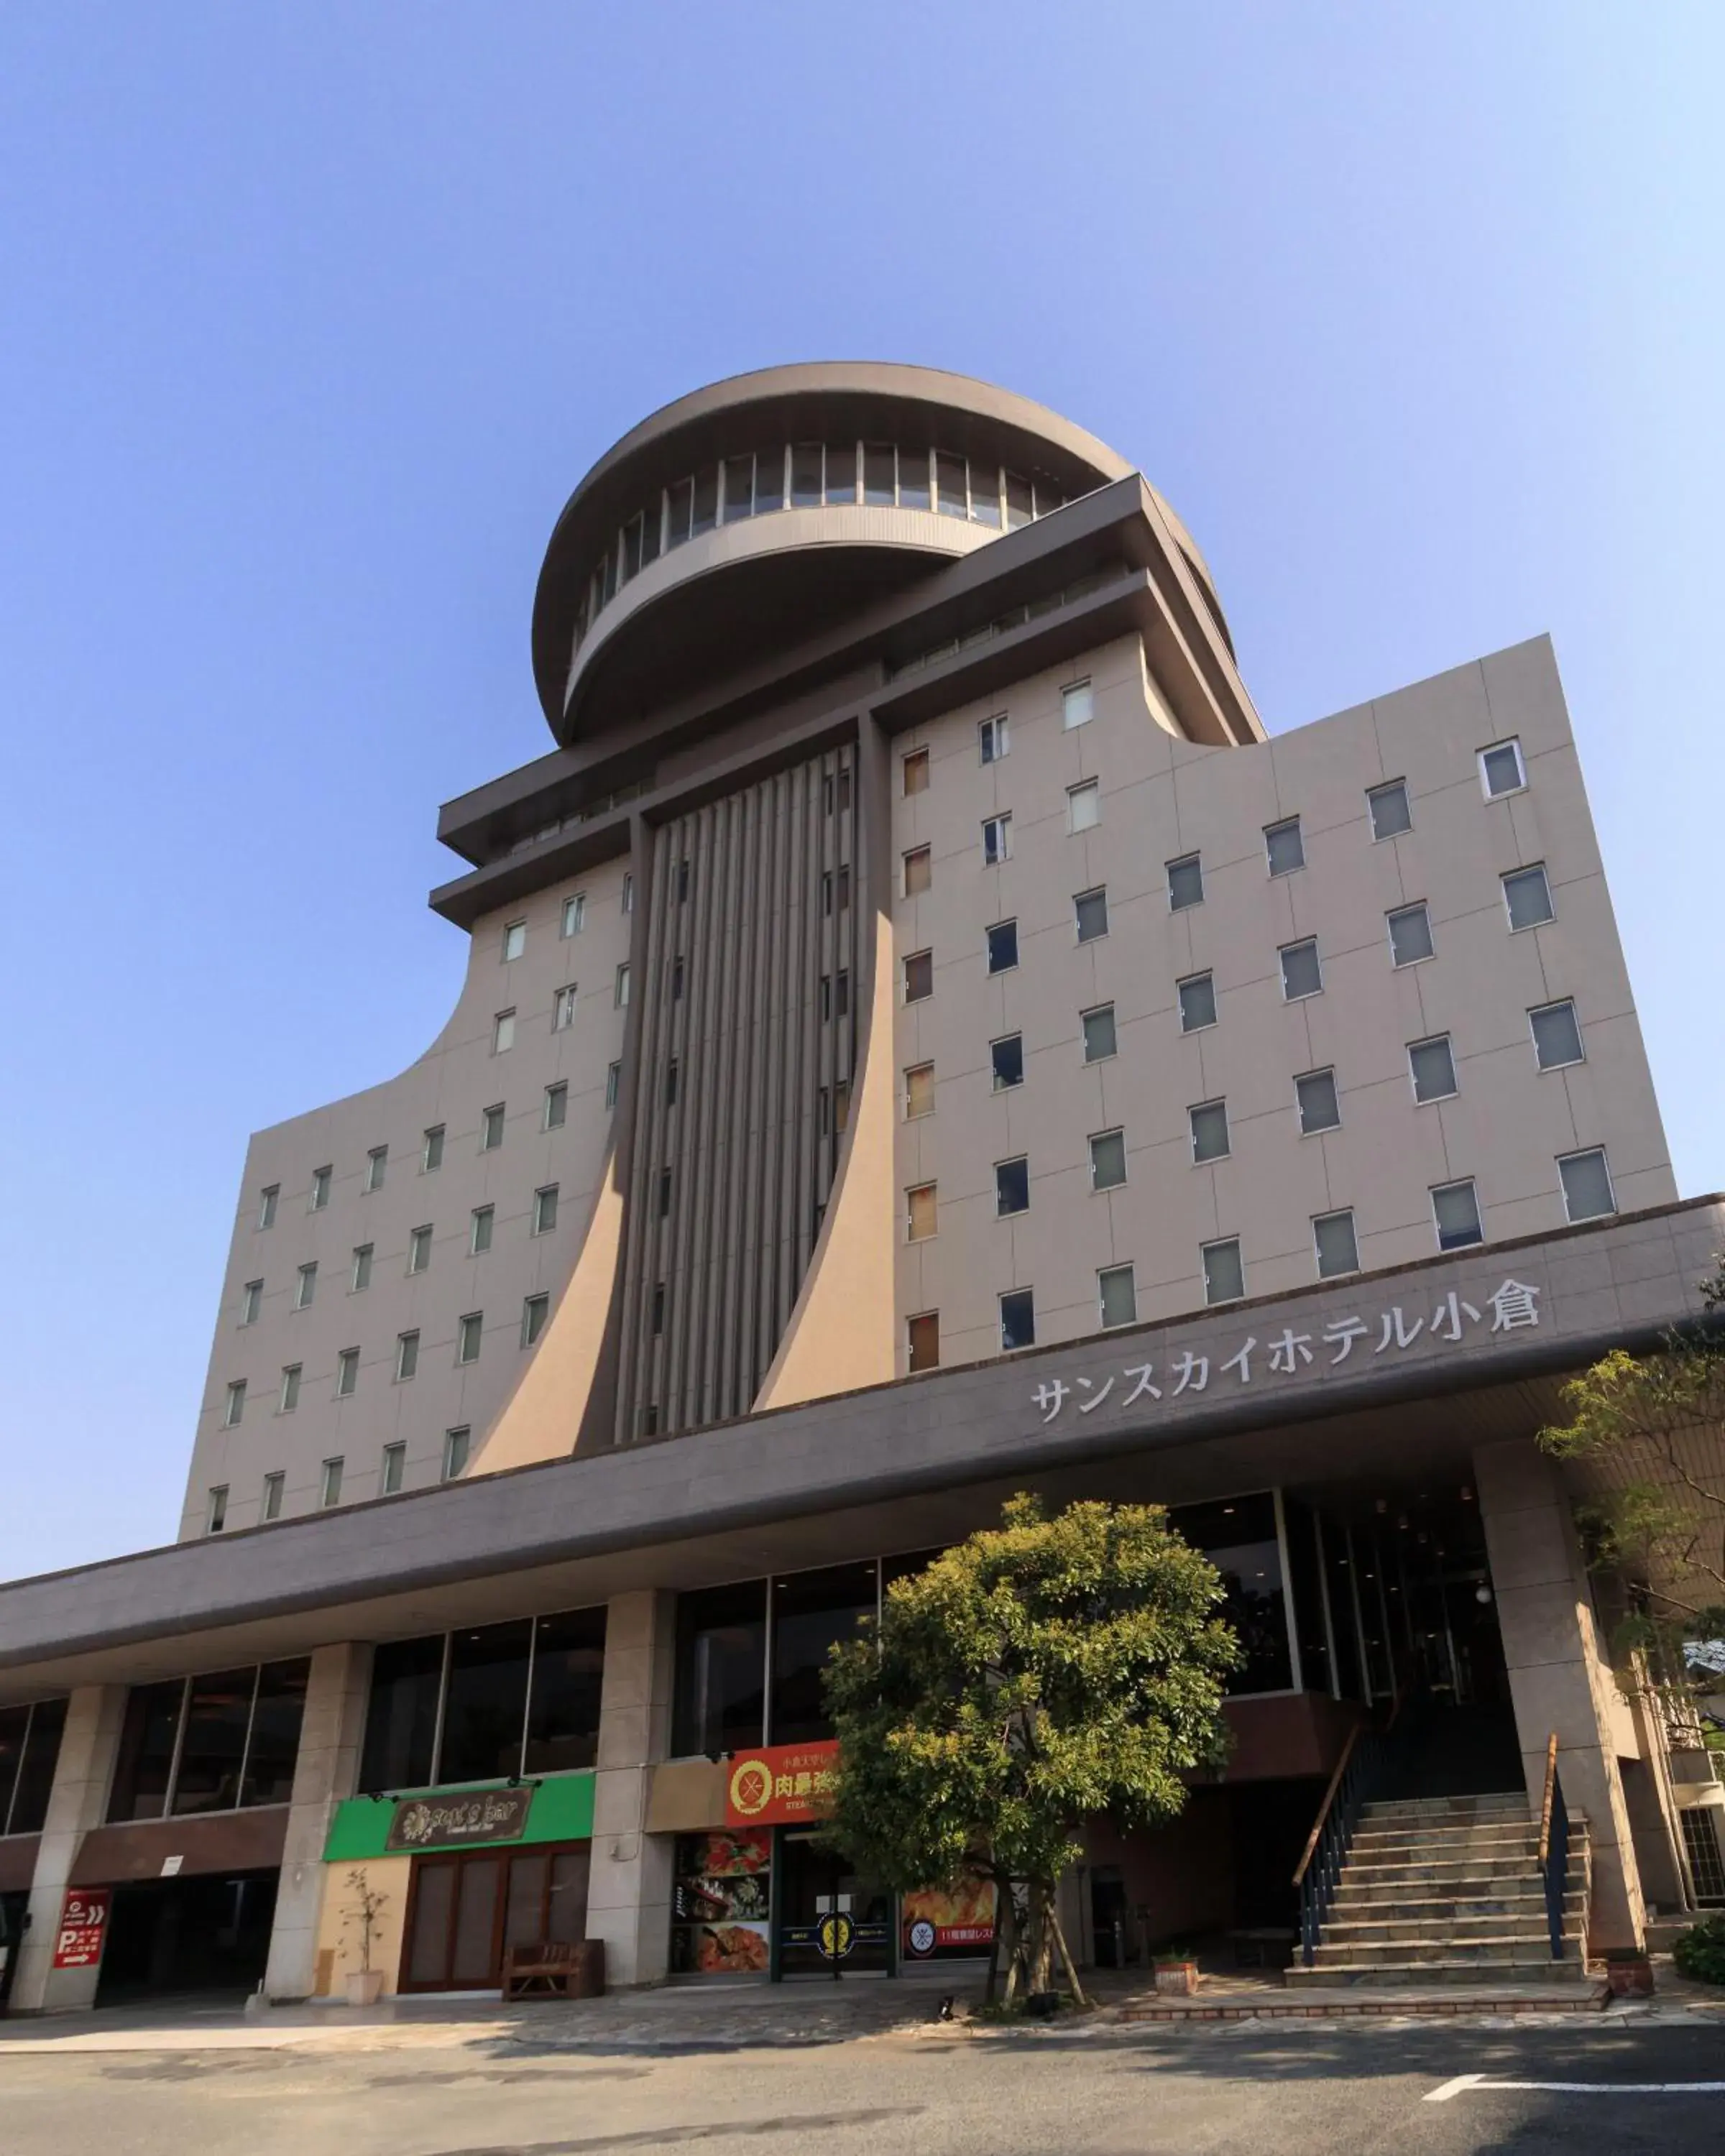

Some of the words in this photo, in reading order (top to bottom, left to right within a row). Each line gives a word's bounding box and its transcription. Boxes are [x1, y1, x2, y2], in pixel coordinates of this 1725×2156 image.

[1031, 1278, 1540, 1424] サンスカイホテル小倉
[483, 1795, 518, 1823] bar
[58, 1930, 77, 1954] P
